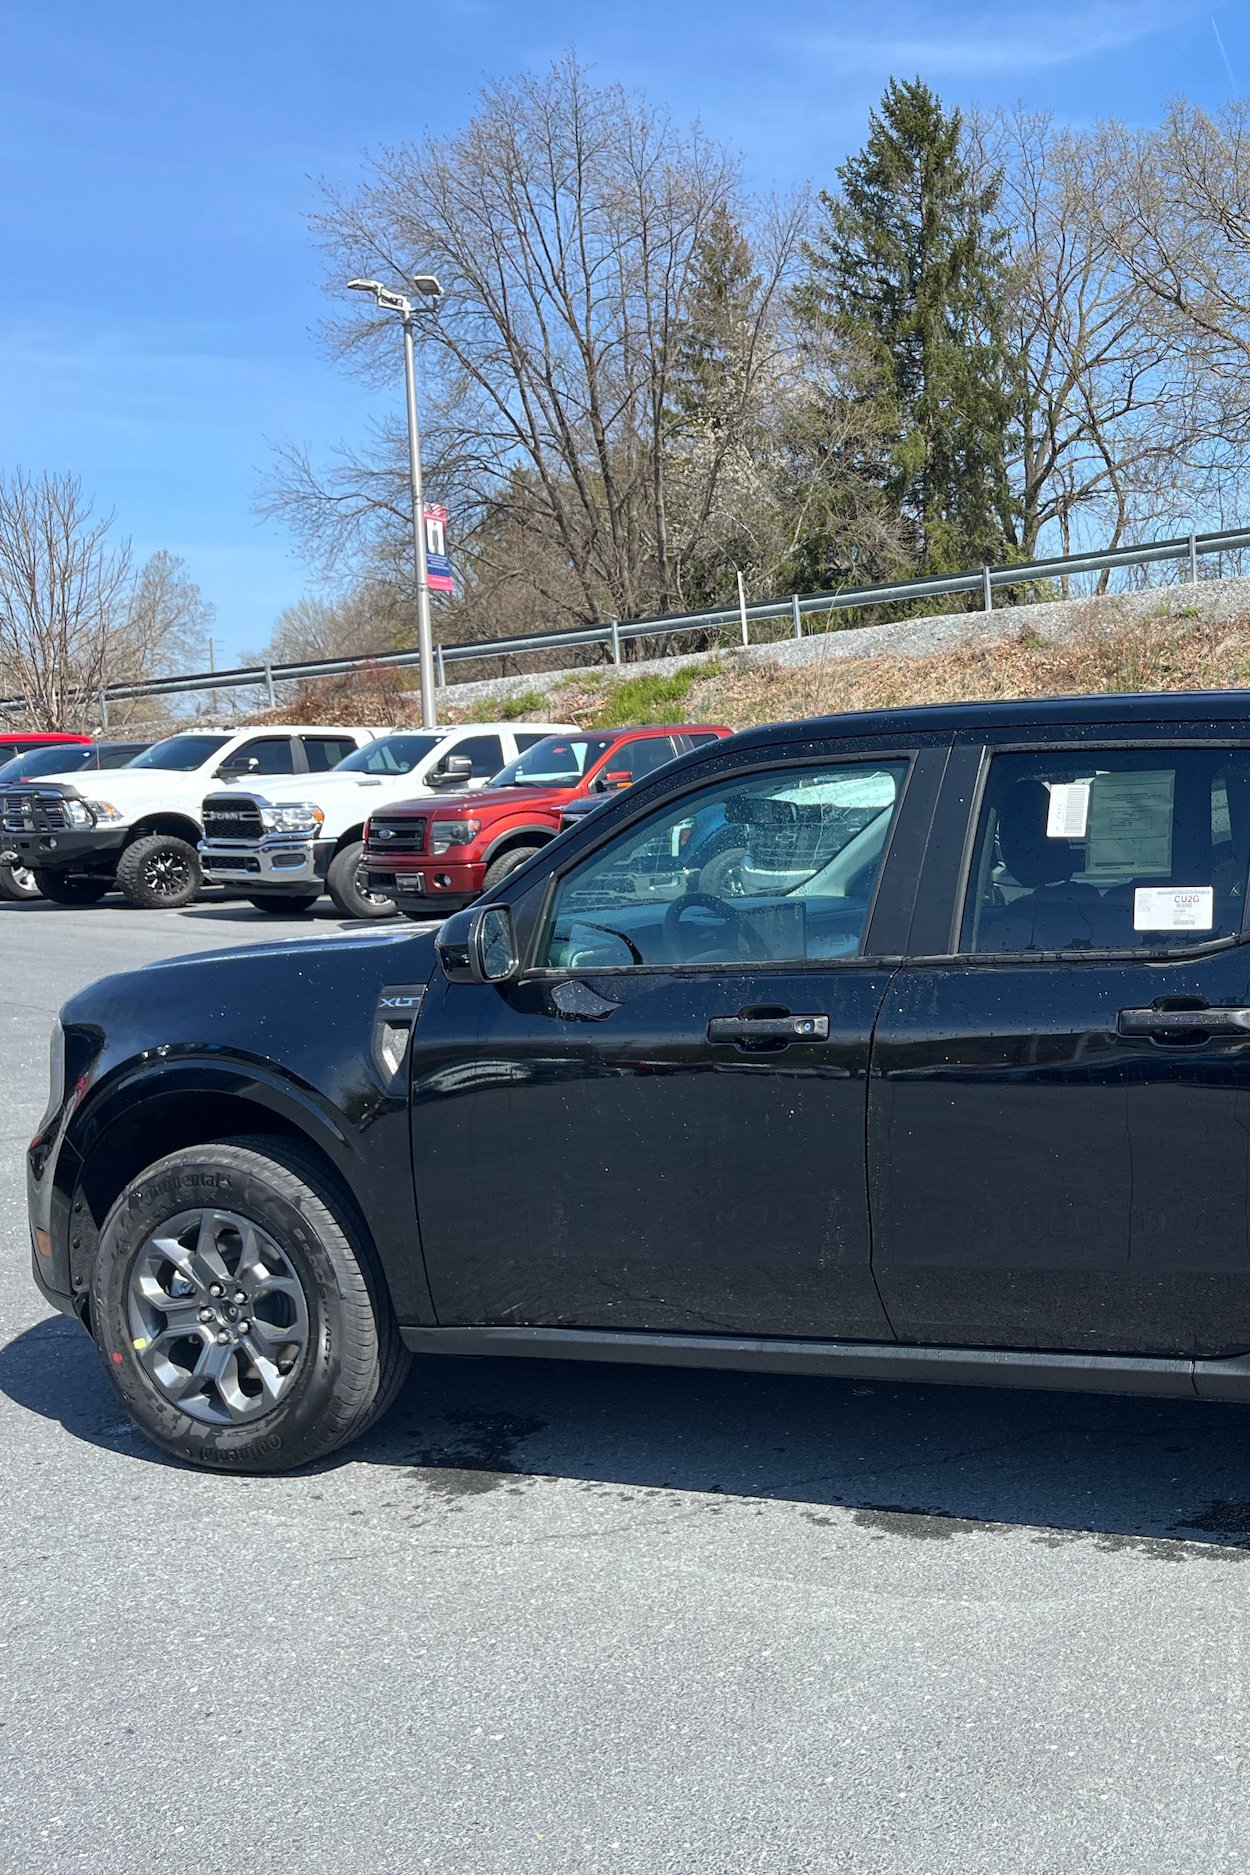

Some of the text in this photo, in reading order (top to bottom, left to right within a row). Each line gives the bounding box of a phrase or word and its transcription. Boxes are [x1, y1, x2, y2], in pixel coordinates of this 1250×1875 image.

[1174, 895, 1200, 903] CU2G
[378, 996, 421, 1008] XLT
[141, 1171, 221, 1207] Continental
